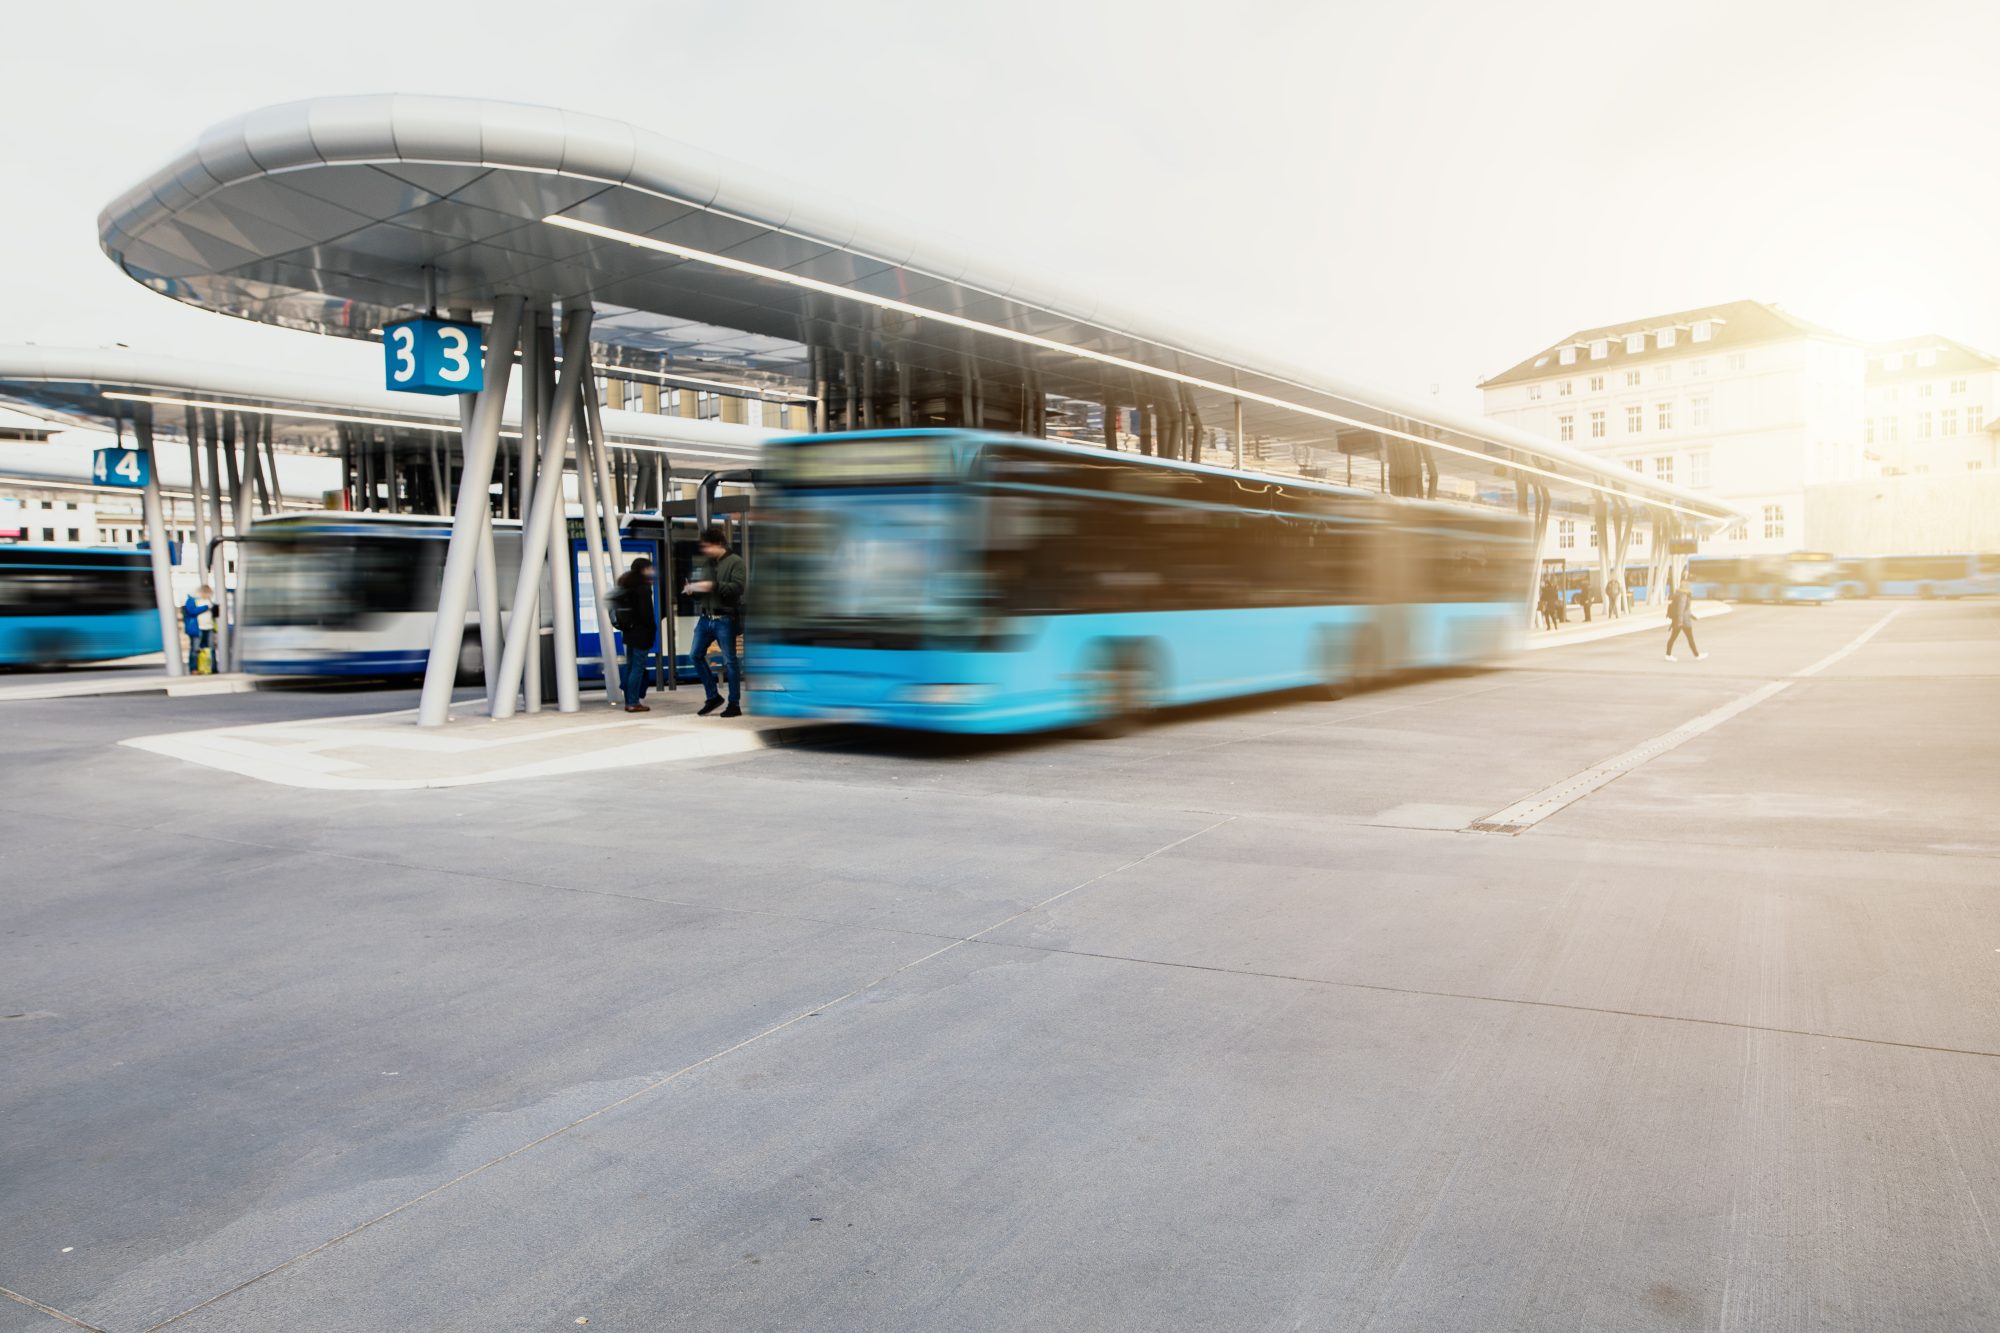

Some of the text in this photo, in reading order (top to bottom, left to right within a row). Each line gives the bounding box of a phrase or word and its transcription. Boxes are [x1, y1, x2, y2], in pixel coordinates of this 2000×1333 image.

[392, 326, 416, 382] 3
[437, 326, 470, 382] 3
[94, 450, 107, 482] 4
[115, 451, 141, 482] 4
